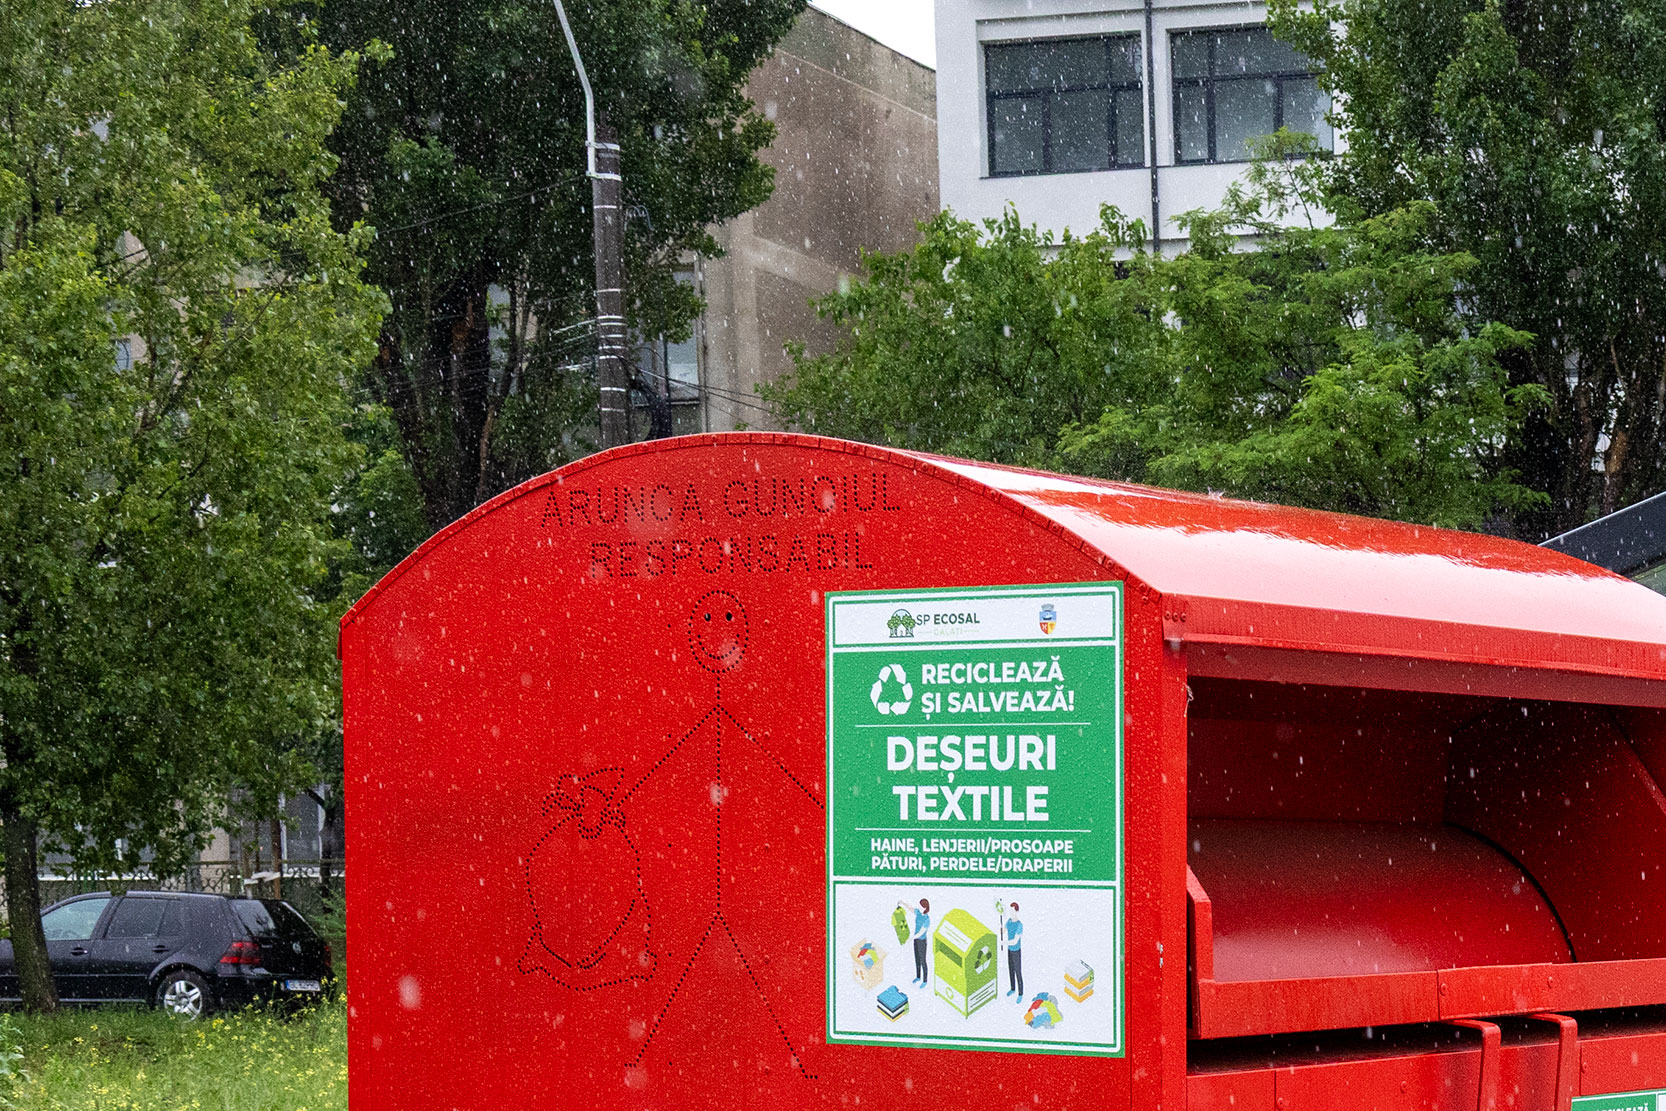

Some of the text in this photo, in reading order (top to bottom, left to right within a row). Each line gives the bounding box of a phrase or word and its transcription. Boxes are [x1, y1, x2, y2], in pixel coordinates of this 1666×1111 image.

[541, 473, 900, 527] ARUNCA GUNOIUL
[591, 532, 873, 577] RESPONSABIL
[915, 611, 980, 627] SP ECOSAL
[921, 655, 1065, 685] RECICLEAZĂ
[921, 682, 1075, 720] ȘI SALVEAZĂ!
[886, 735, 1057, 781] DEȘEURI
[893, 785, 1050, 821] TEXTILE
[871, 837, 1074, 855] HAINE, LENJERII/PROSOAPE
[871, 852, 1073, 874] PĂTURI, PERDELE/DRAPERII
